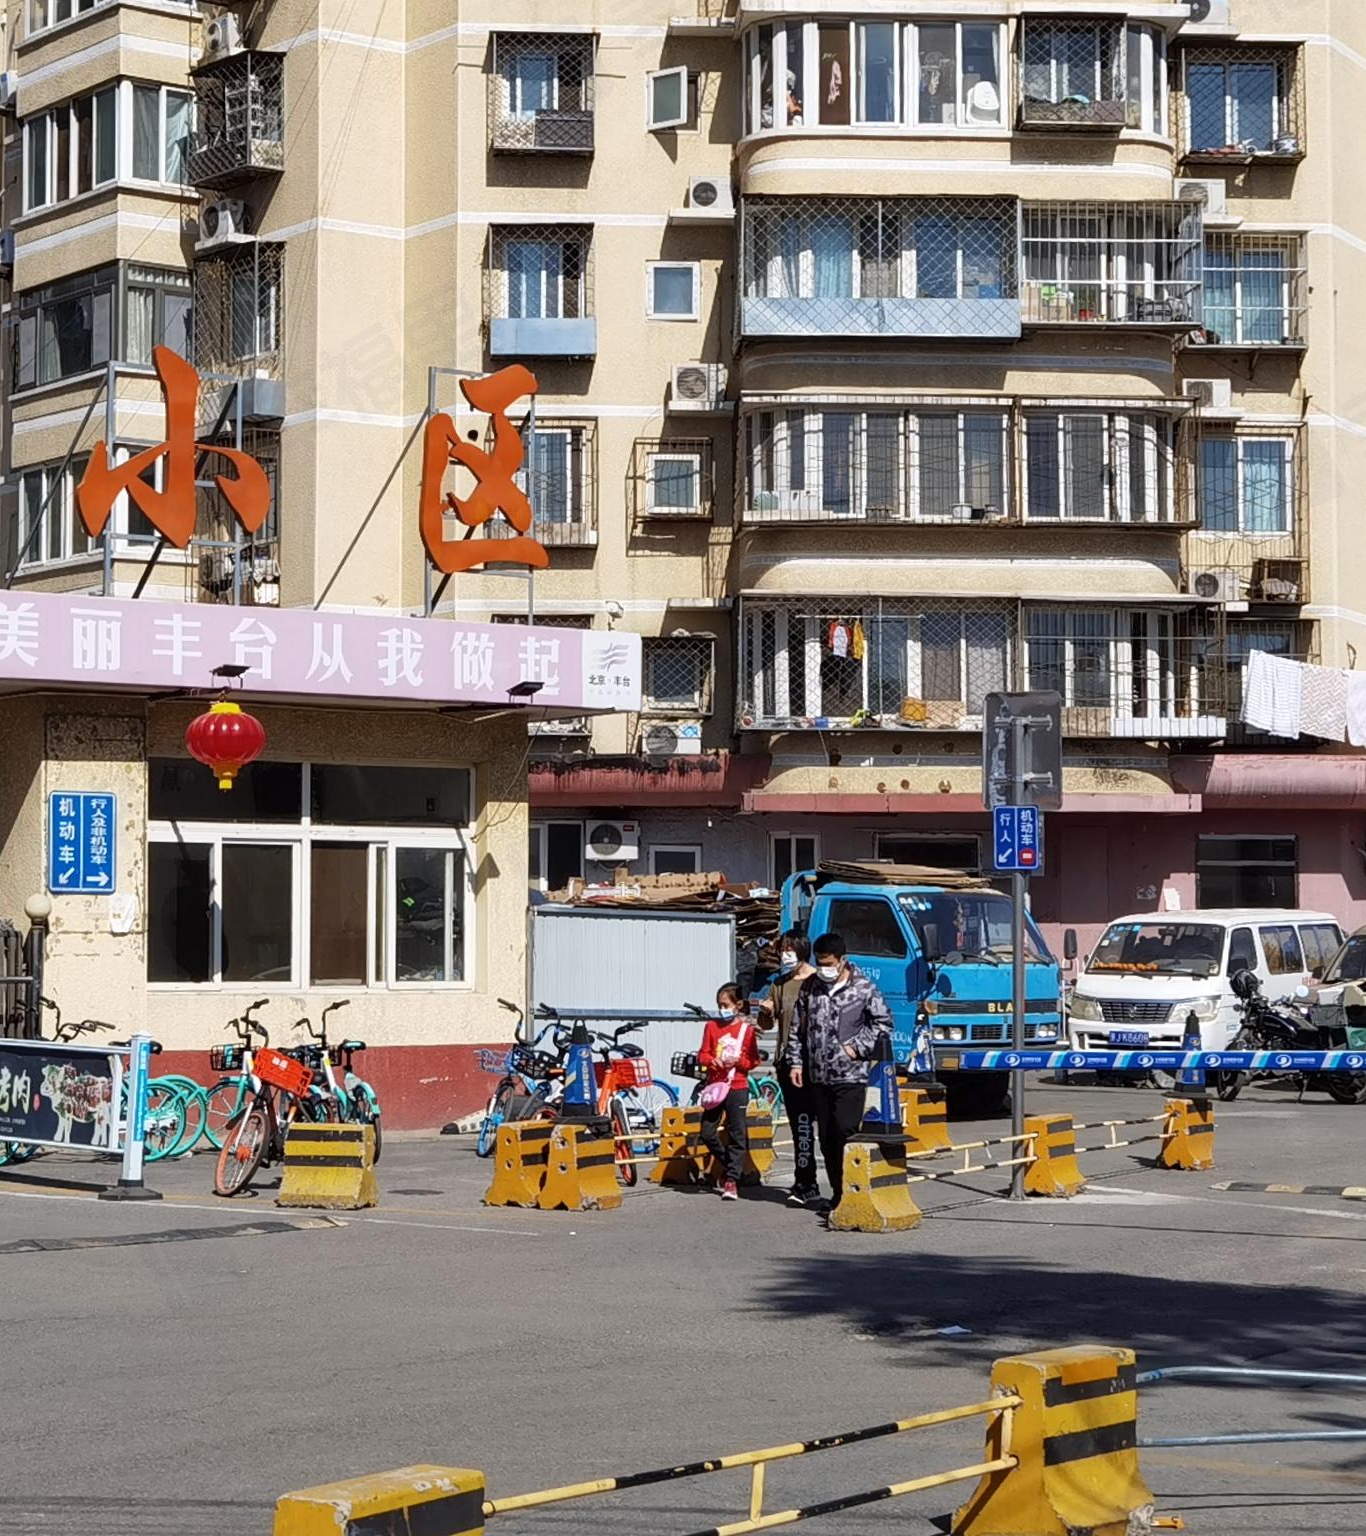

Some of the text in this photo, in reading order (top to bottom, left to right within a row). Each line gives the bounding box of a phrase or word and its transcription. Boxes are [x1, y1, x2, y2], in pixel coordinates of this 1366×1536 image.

[77, 344, 548, 573] 小区
[58, 797, 76, 864] 机动车
[90, 798, 108, 865] 行人及非机动车
[1000, 814, 1012, 843] 行人
[1020, 810, 1034, 846] 机动车
[988, 1002, 1014, 1013] BLA
[797, 1112, 812, 1168] athlete
